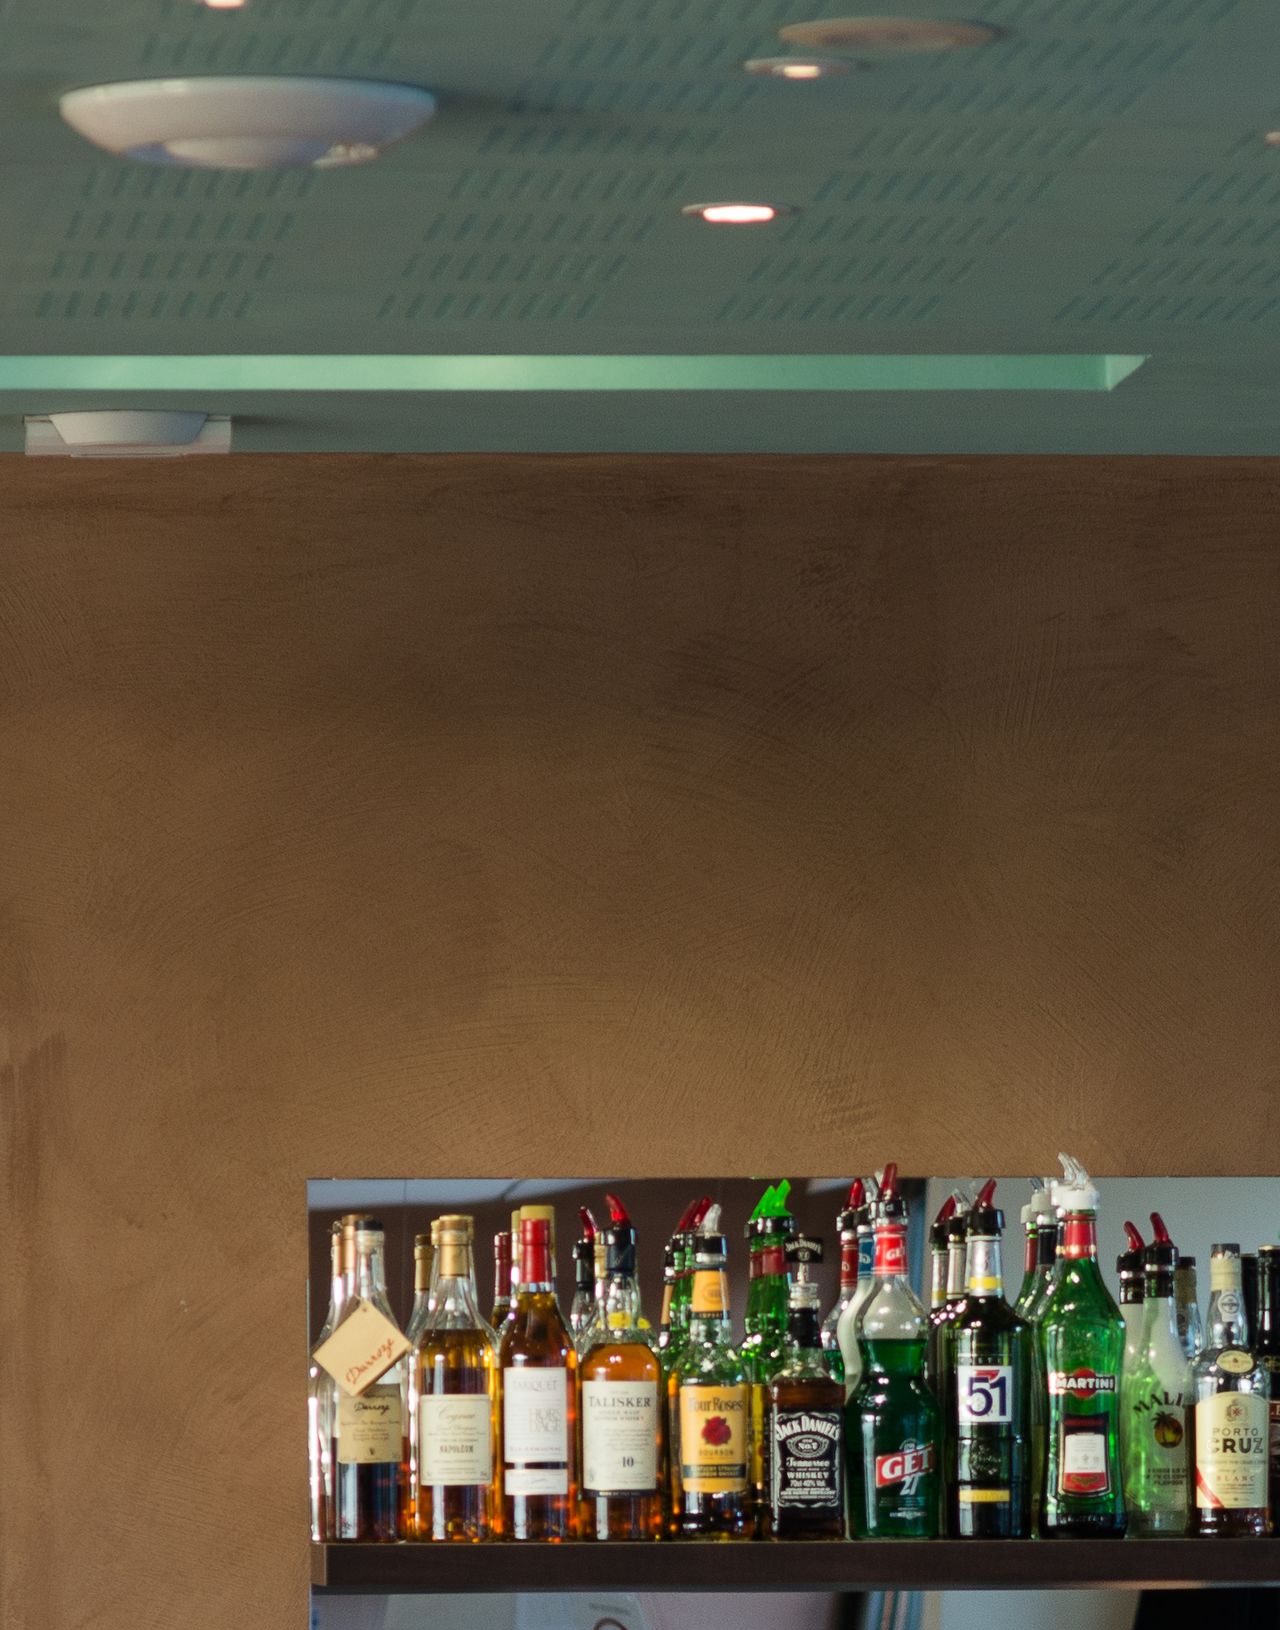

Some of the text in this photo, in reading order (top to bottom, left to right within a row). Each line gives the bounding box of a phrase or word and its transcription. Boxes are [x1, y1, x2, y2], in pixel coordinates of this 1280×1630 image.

[345, 1337, 395, 1385] Darroze
[1057, 1377, 1114, 1389] MARTINI
[588, 1396, 651, 1408] TALISKER
[966, 1375, 1007, 1417] 51
[712, 1397, 743, 1412] Roses
[774, 1415, 841, 1441] JACK DANIEL'S
[1212, 1427, 1258, 1437] PORTO
[1210, 1437, 1264, 1454] CRUZ
[622, 1456, 635, 1468] 10
[881, 1447, 932, 1479] GET
[786, 1471, 830, 1479] WHISKEY
[900, 1472, 925, 1496] 27
